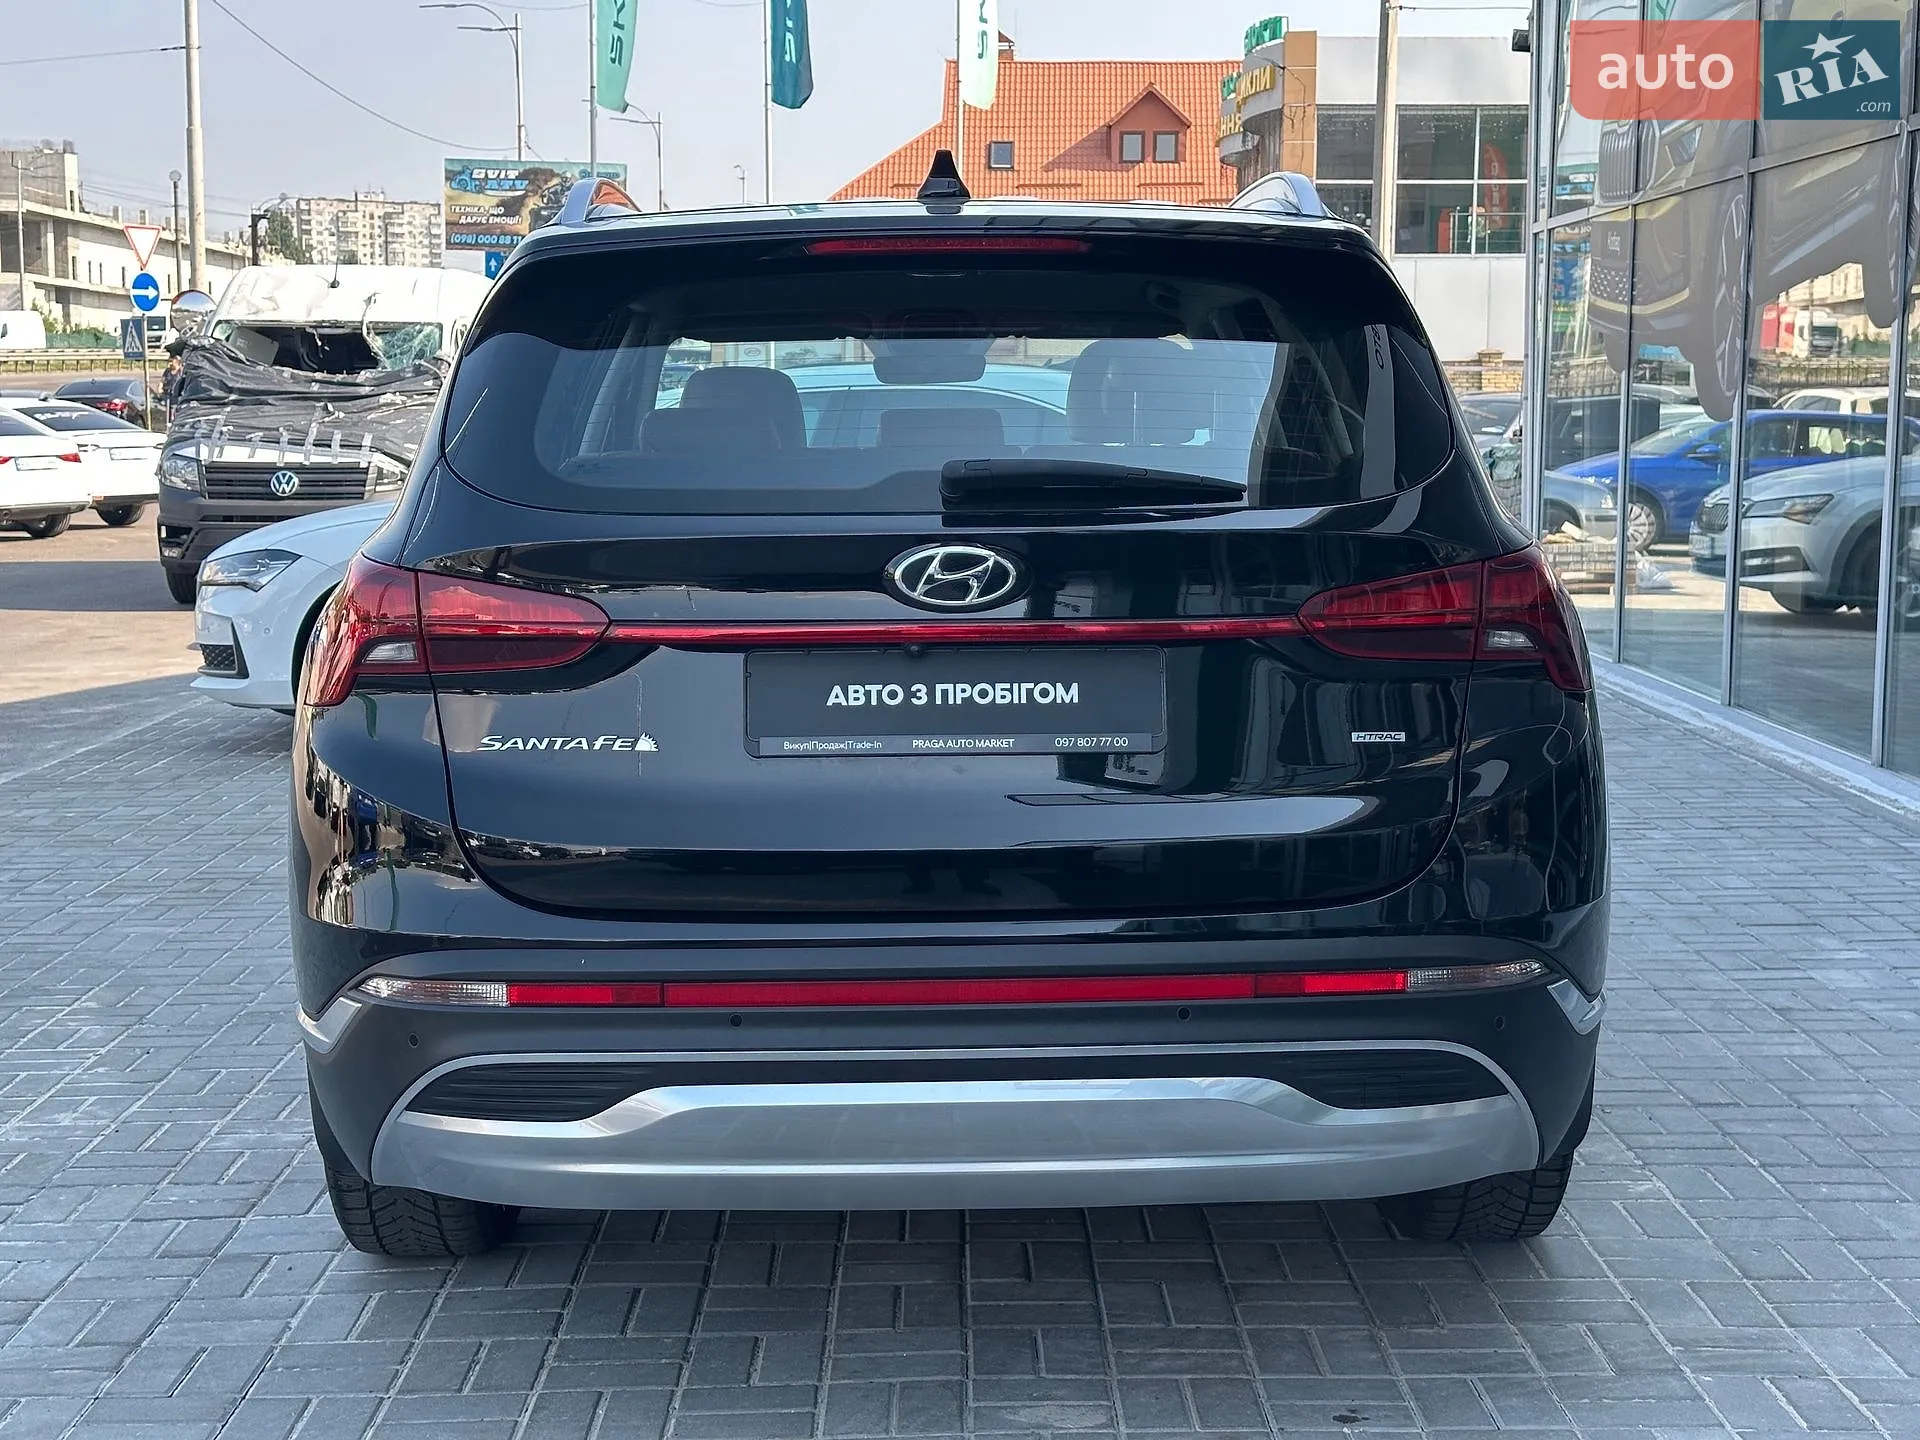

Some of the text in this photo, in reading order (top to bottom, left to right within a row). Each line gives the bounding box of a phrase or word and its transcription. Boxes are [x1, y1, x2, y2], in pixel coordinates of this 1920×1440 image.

[478, 234, 498, 244] 000
[825, 683, 904, 706] АВТО
[935, 682, 1080, 705] ПРОБІГОМ
[1054, 737, 1129, 748] 097 807 77 00
[1356, 733, 1402, 741] HTRAC
[912, 738, 1016, 749] PRAGA AUTO MARKET
